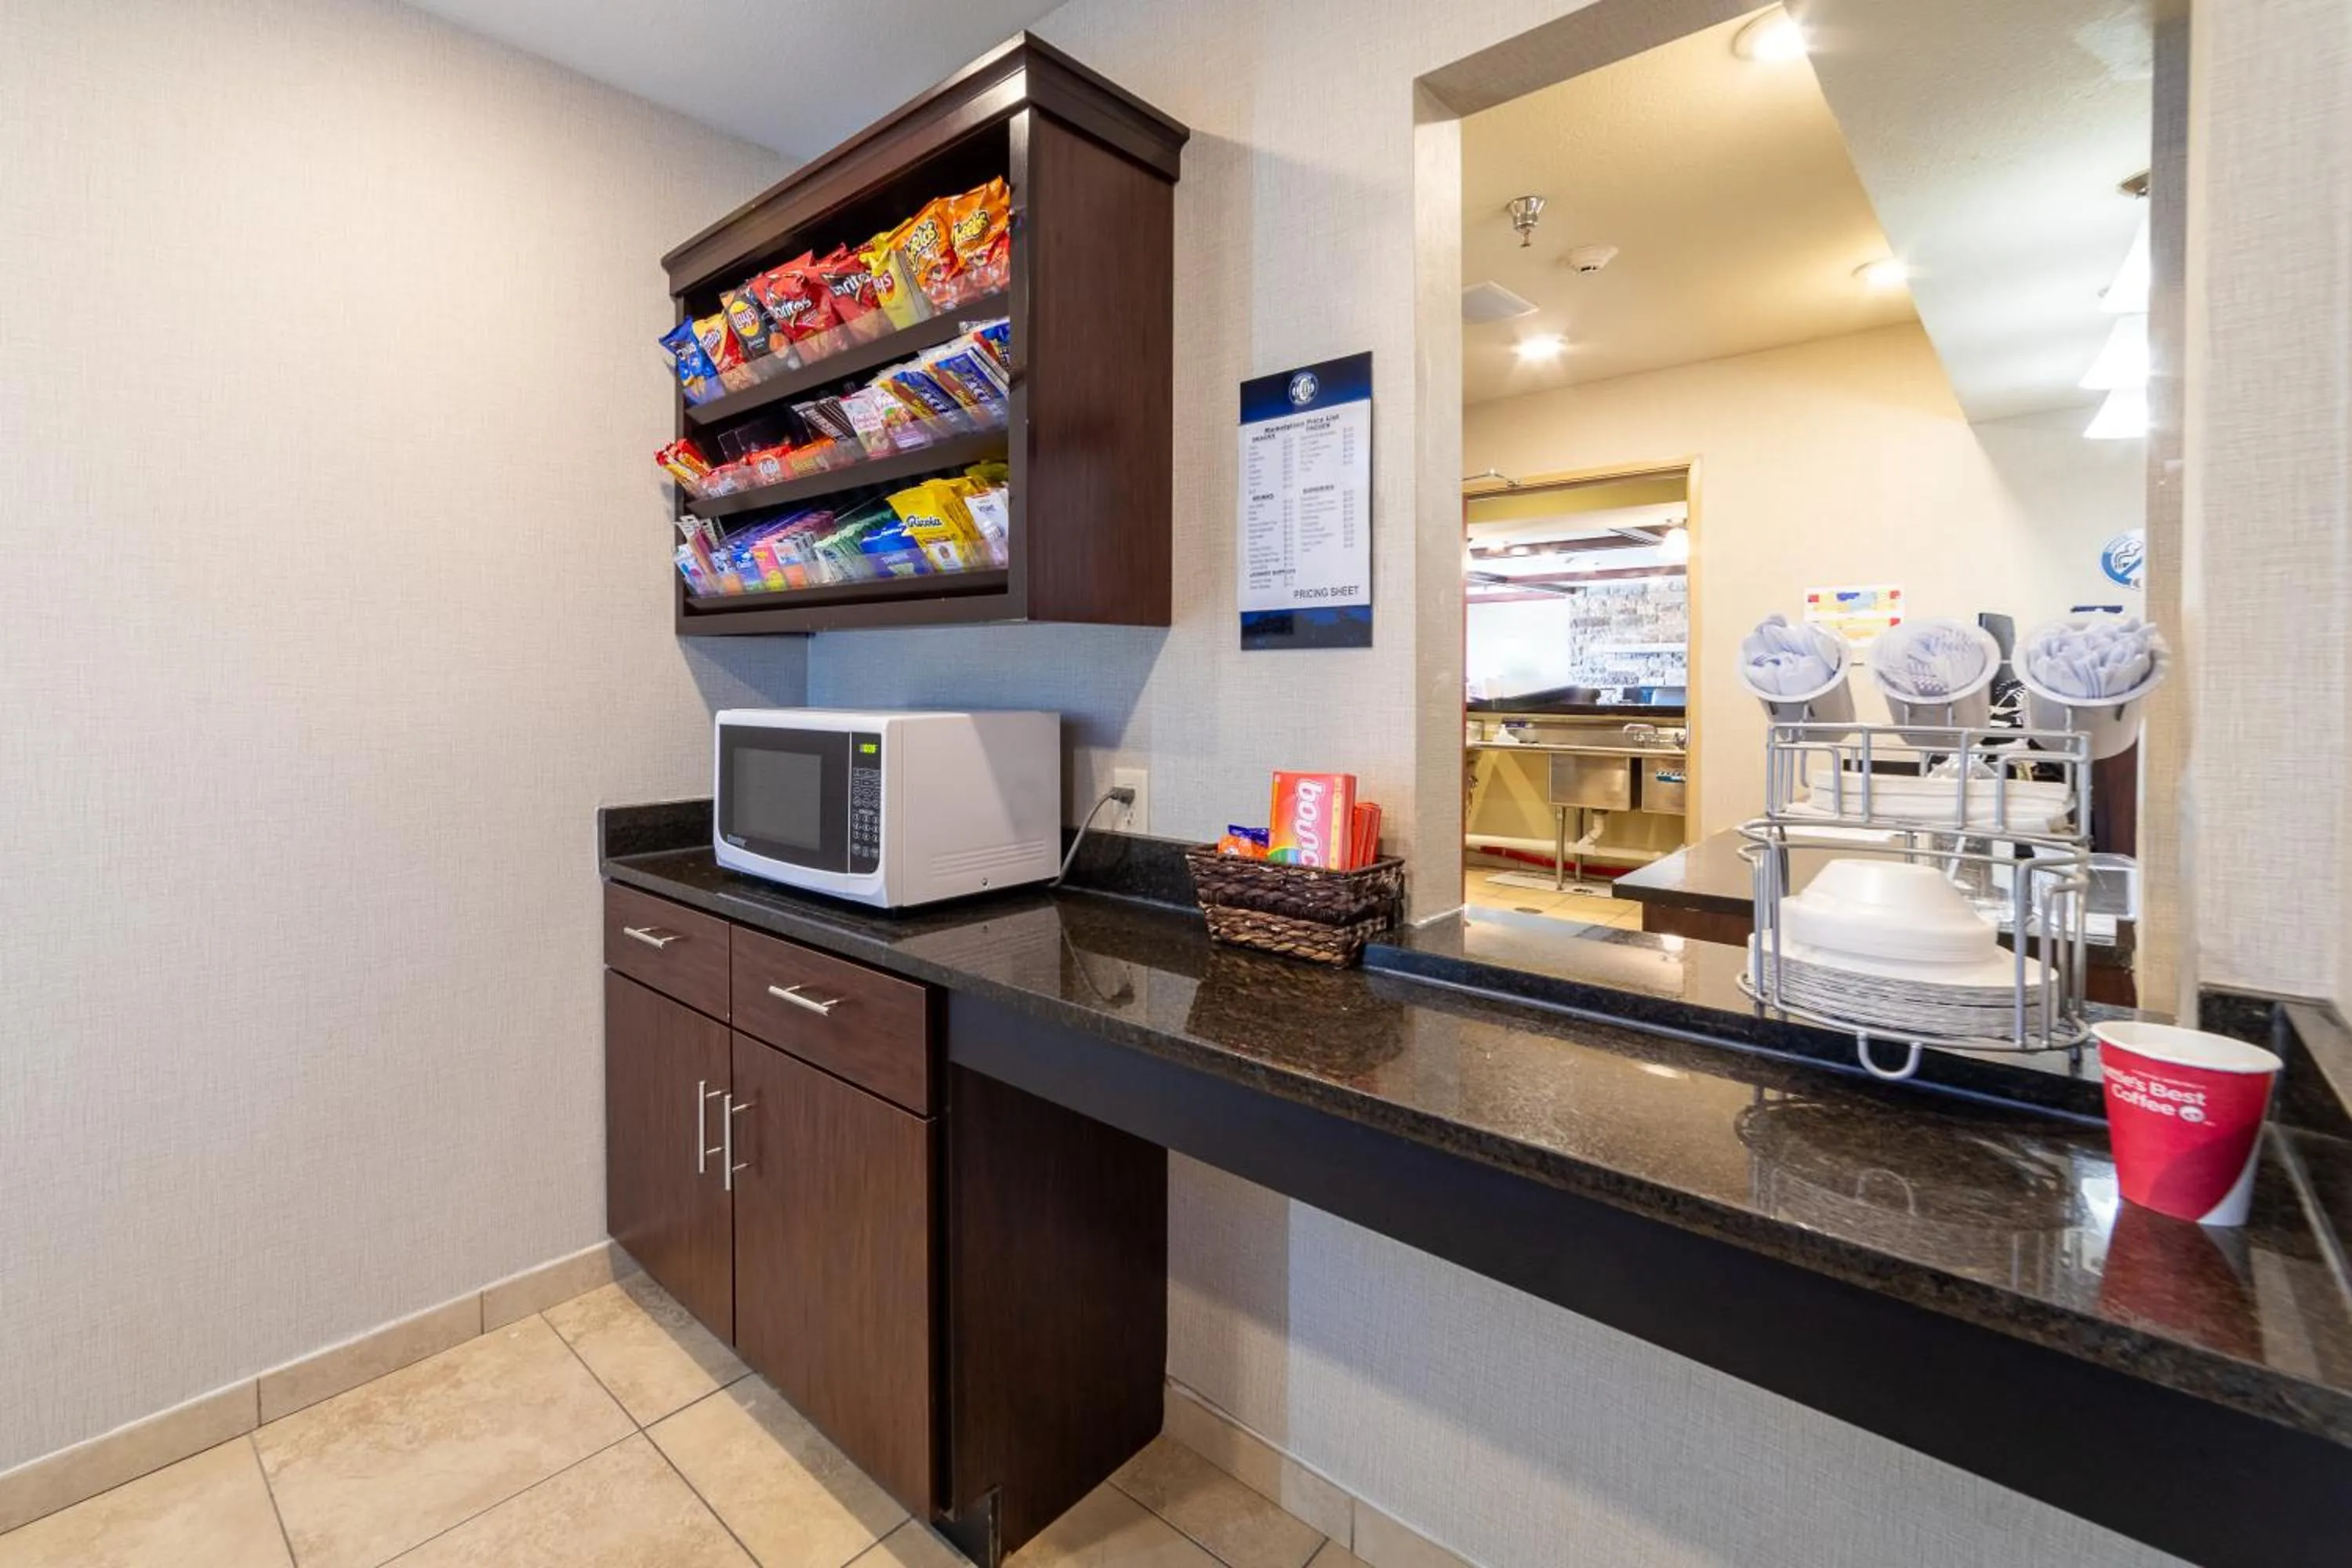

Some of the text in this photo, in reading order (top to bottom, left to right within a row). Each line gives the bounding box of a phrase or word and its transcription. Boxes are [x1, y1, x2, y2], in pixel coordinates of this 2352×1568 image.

[905, 514, 945, 528] Ricola
[1293, 585, 1360, 599] PRICING SHEET
[2111, 1083, 2176, 1116] Coffee
[2149, 1081, 2207, 1106] Best
